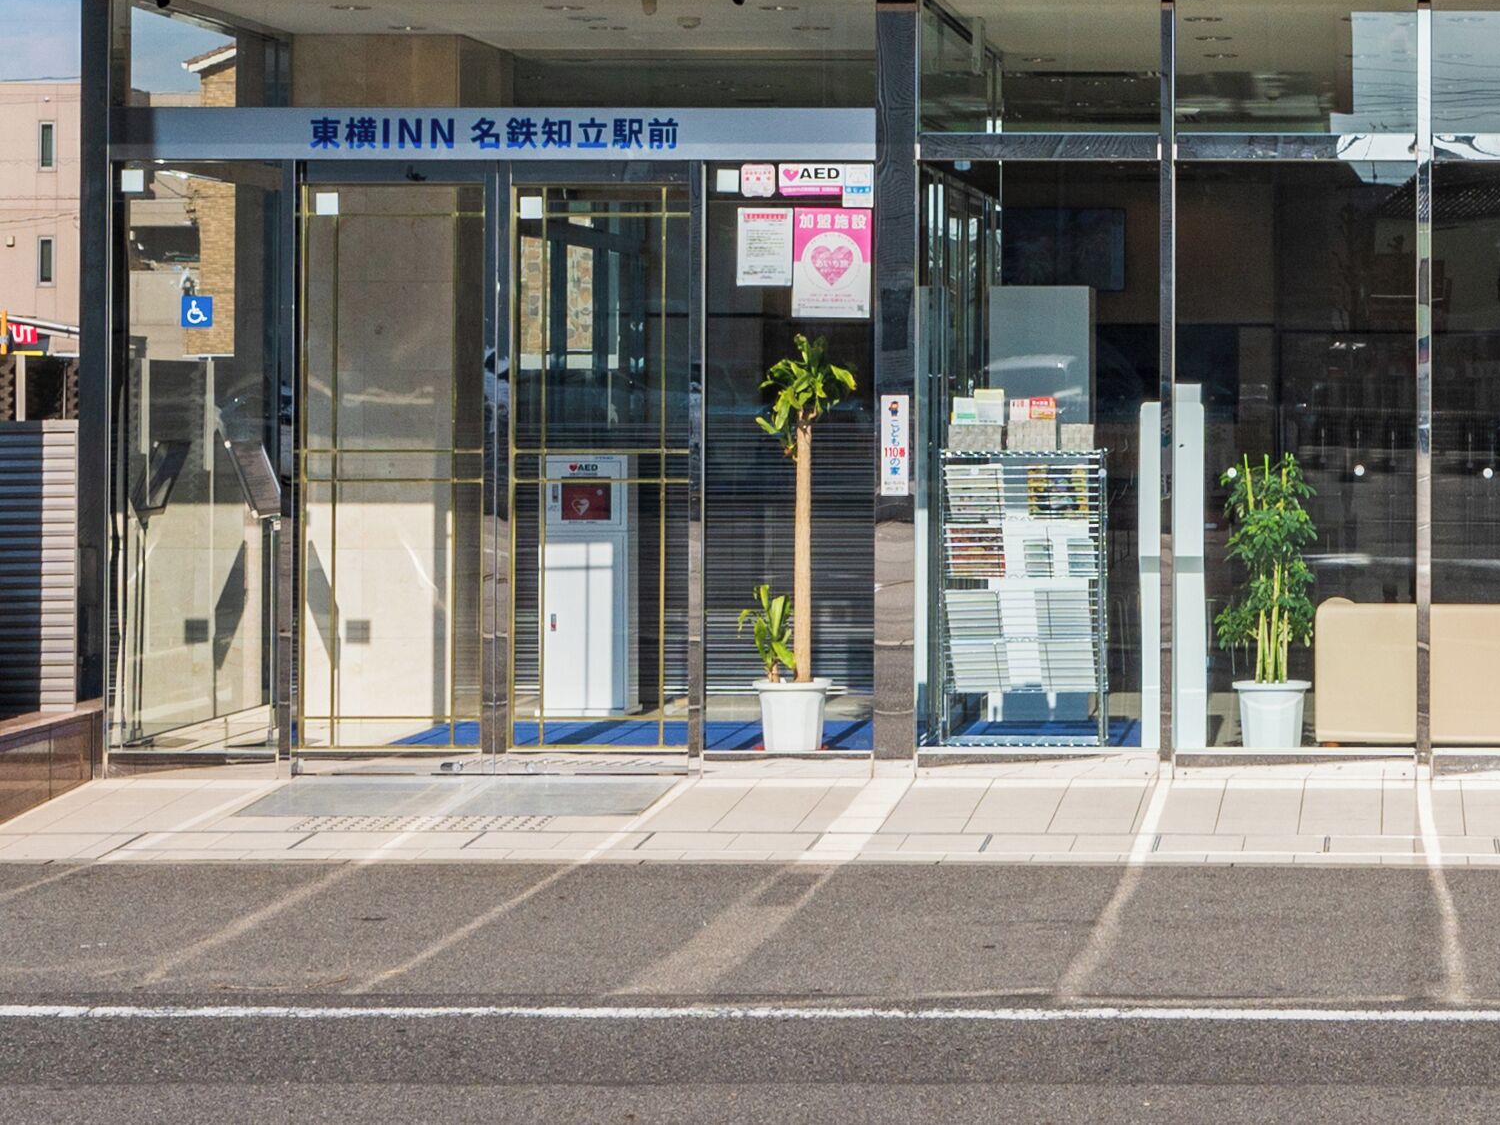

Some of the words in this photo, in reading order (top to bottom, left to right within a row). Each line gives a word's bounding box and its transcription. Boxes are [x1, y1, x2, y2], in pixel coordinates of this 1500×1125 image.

[309, 117, 456, 149] 東横INN
[470, 117, 679, 149] 名鉄知立駅前
[800, 167, 840, 179] AED
[799, 213, 867, 230] 加盟施設
[7, 323, 35, 342] UT
[578, 463, 598, 472] AED
